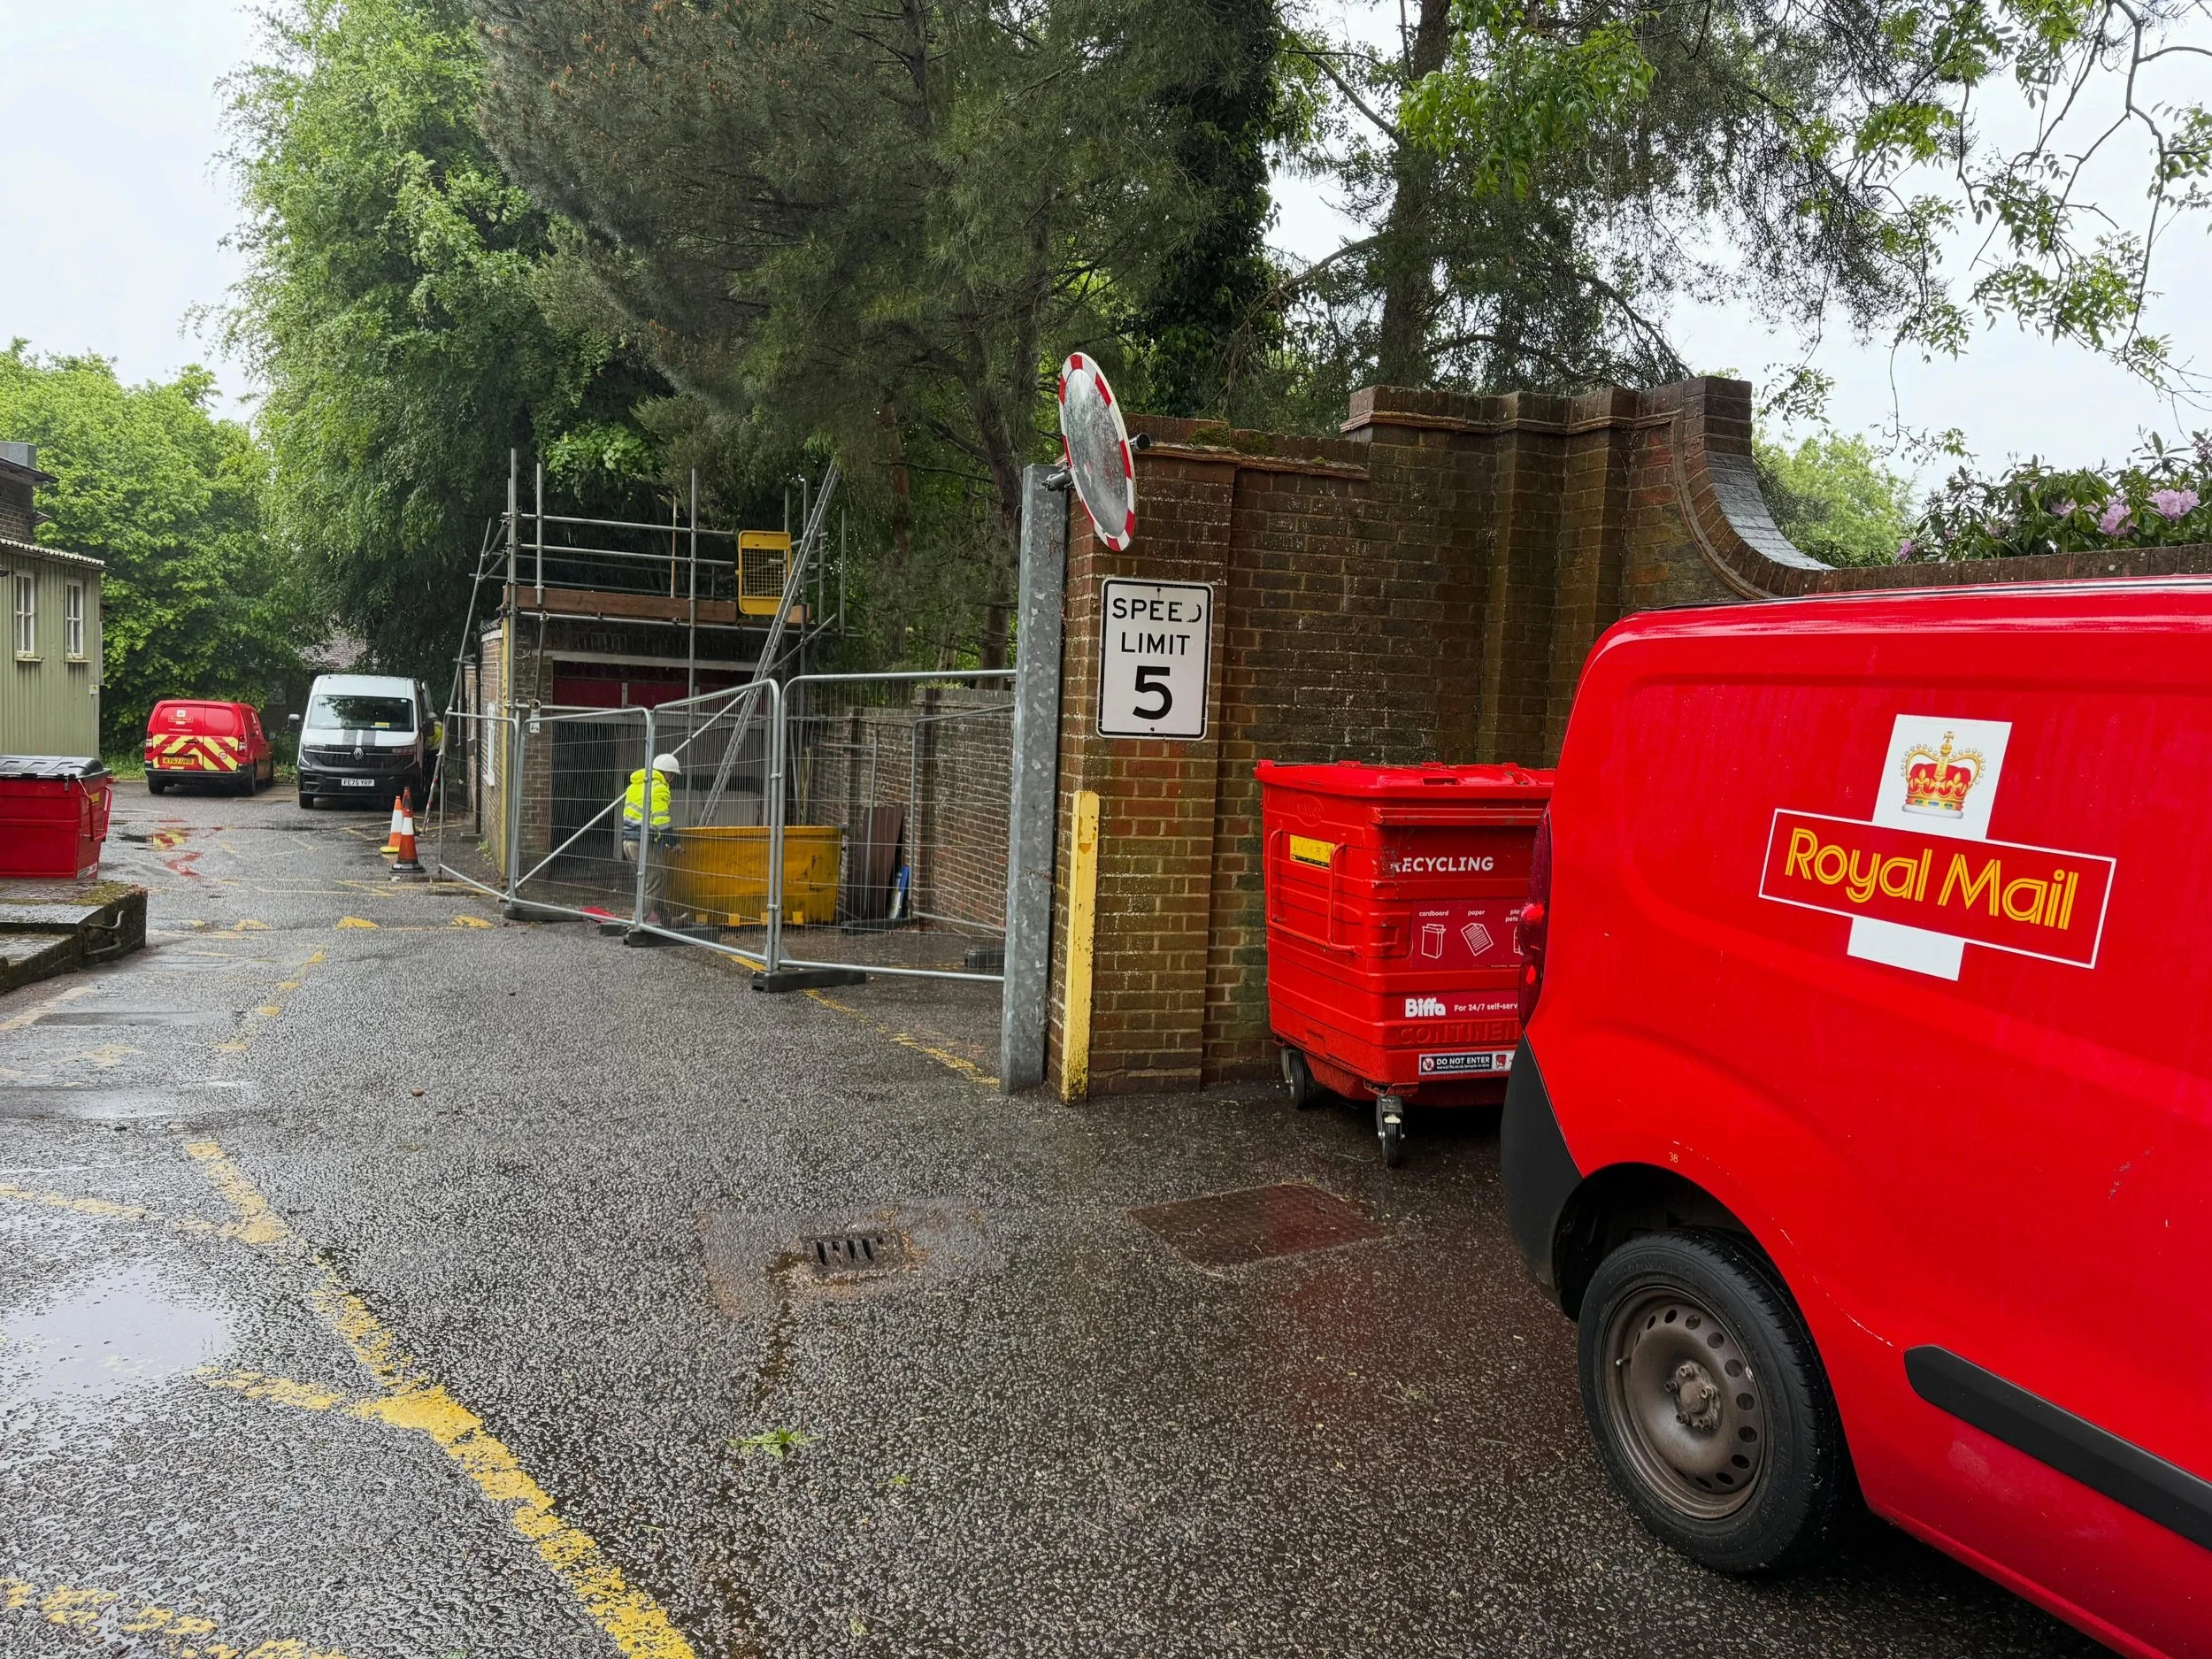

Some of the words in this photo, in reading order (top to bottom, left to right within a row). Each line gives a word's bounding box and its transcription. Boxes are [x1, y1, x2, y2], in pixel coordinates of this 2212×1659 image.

[1121, 632, 1191, 656] LIMIT
[1133, 665, 1173, 720] 5
[1784, 827, 1933, 903] Royal
[1937, 852, 2079, 930] Mail
[1405, 997, 1447, 1018] Biffa
[1468, 1003, 1486, 1012] 24/7
